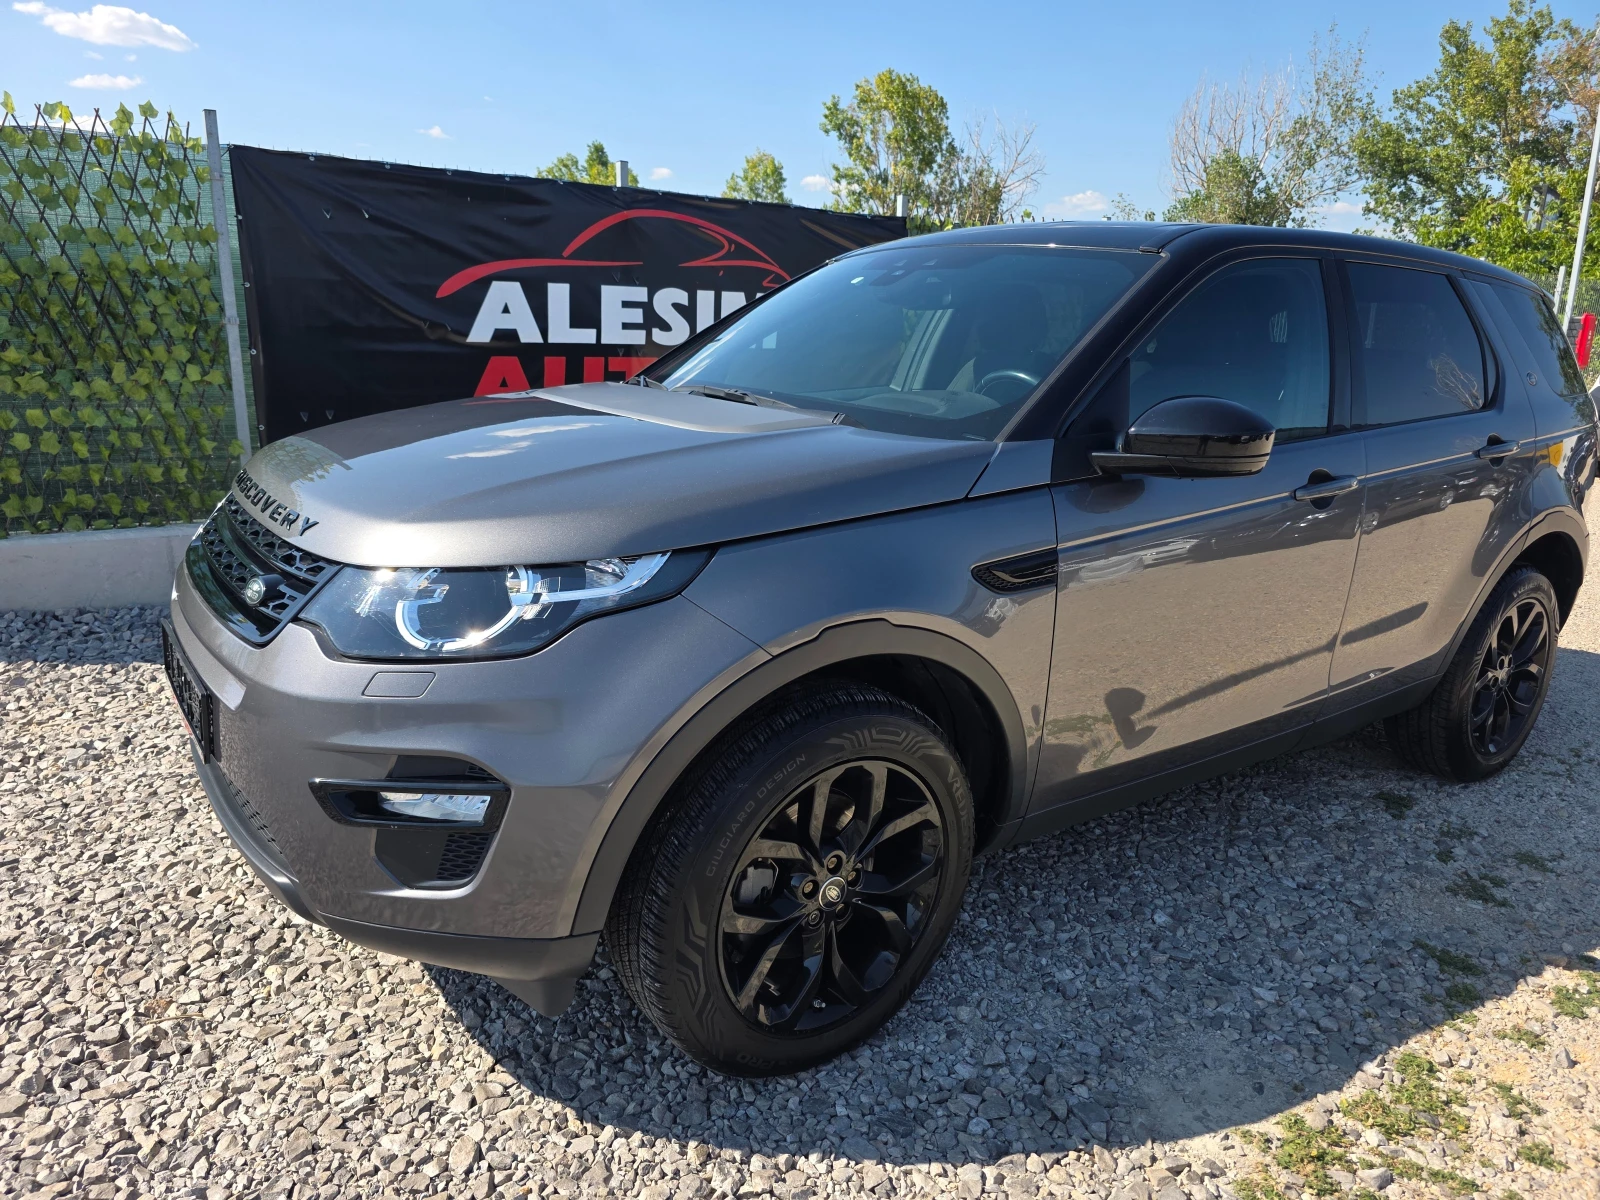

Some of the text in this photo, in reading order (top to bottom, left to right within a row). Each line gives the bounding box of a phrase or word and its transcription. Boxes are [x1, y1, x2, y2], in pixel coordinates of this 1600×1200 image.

[236, 468, 319, 537] DISCOVERY
[705, 753, 807, 877] GIUGIARO DESIGN
